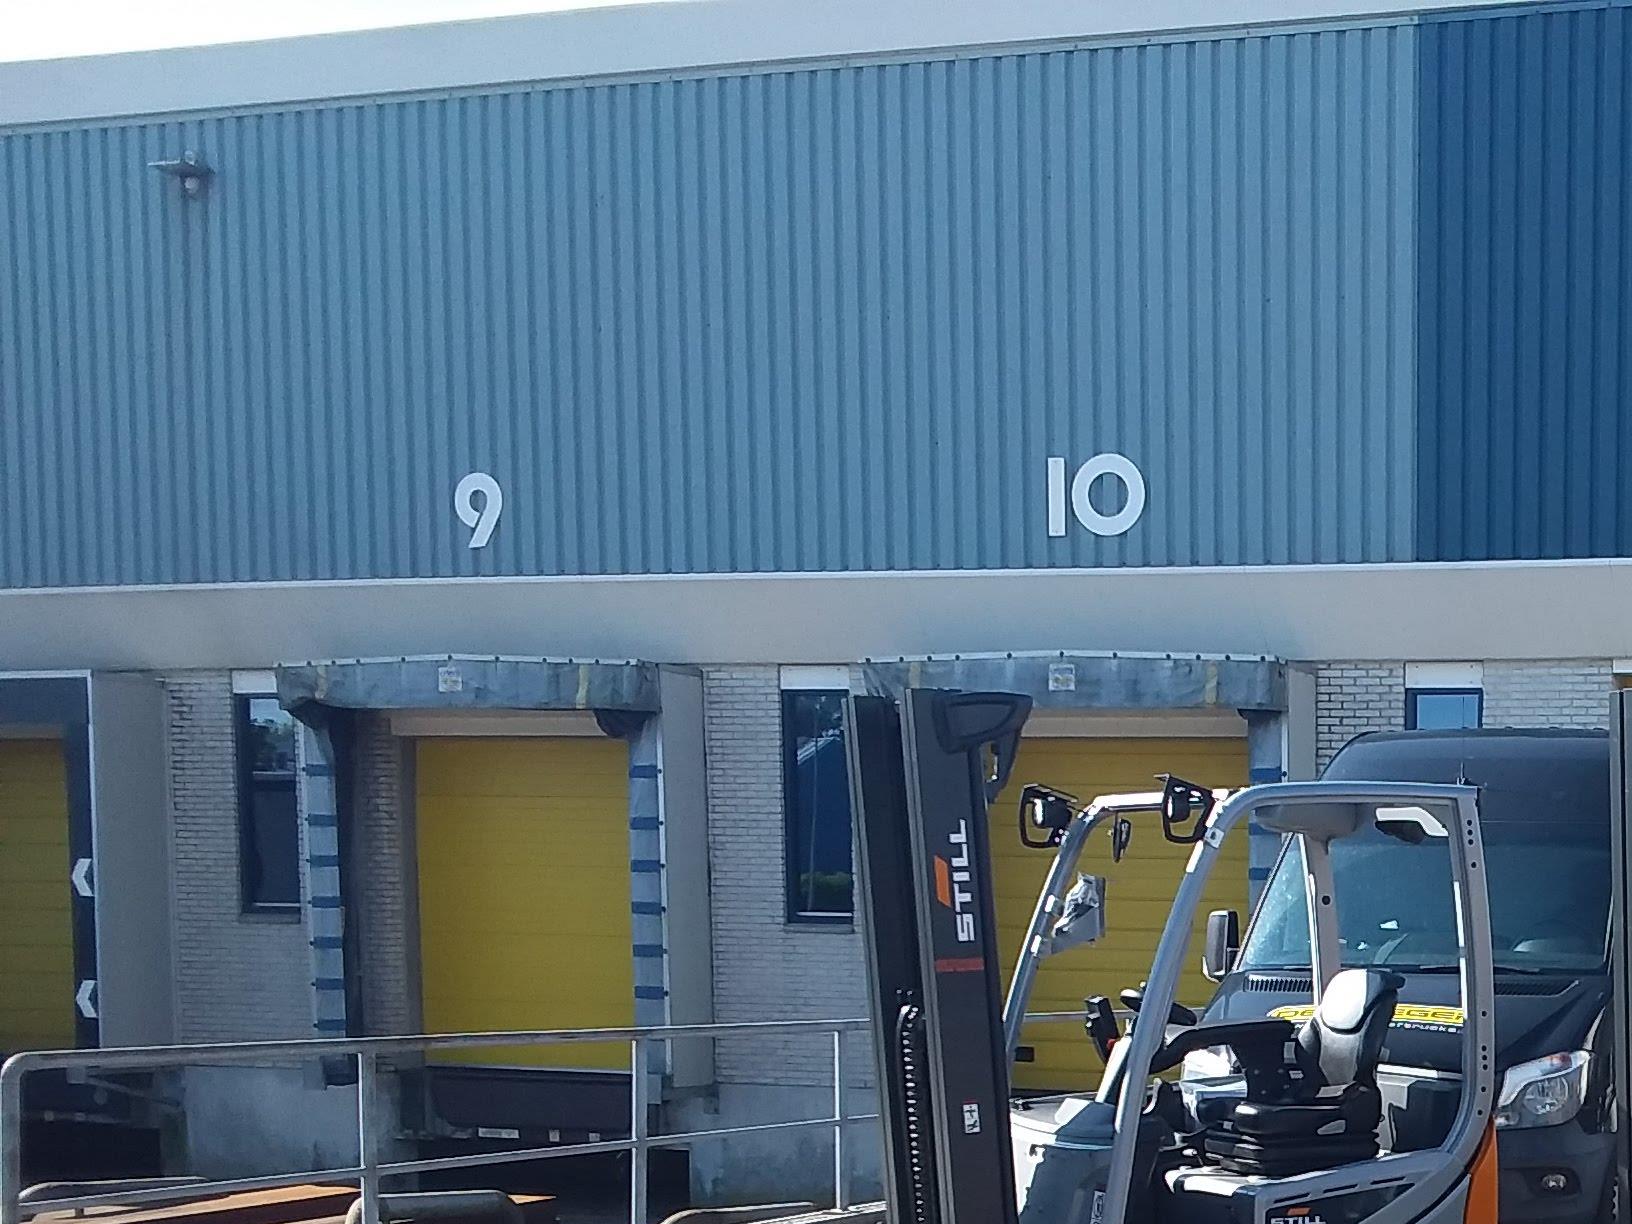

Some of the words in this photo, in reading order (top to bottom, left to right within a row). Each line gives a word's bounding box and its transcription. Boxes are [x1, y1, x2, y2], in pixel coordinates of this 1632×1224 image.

[454, 472, 503, 548] 9
[1047, 453, 1146, 537] 10
[949, 818, 977, 942] STILL
